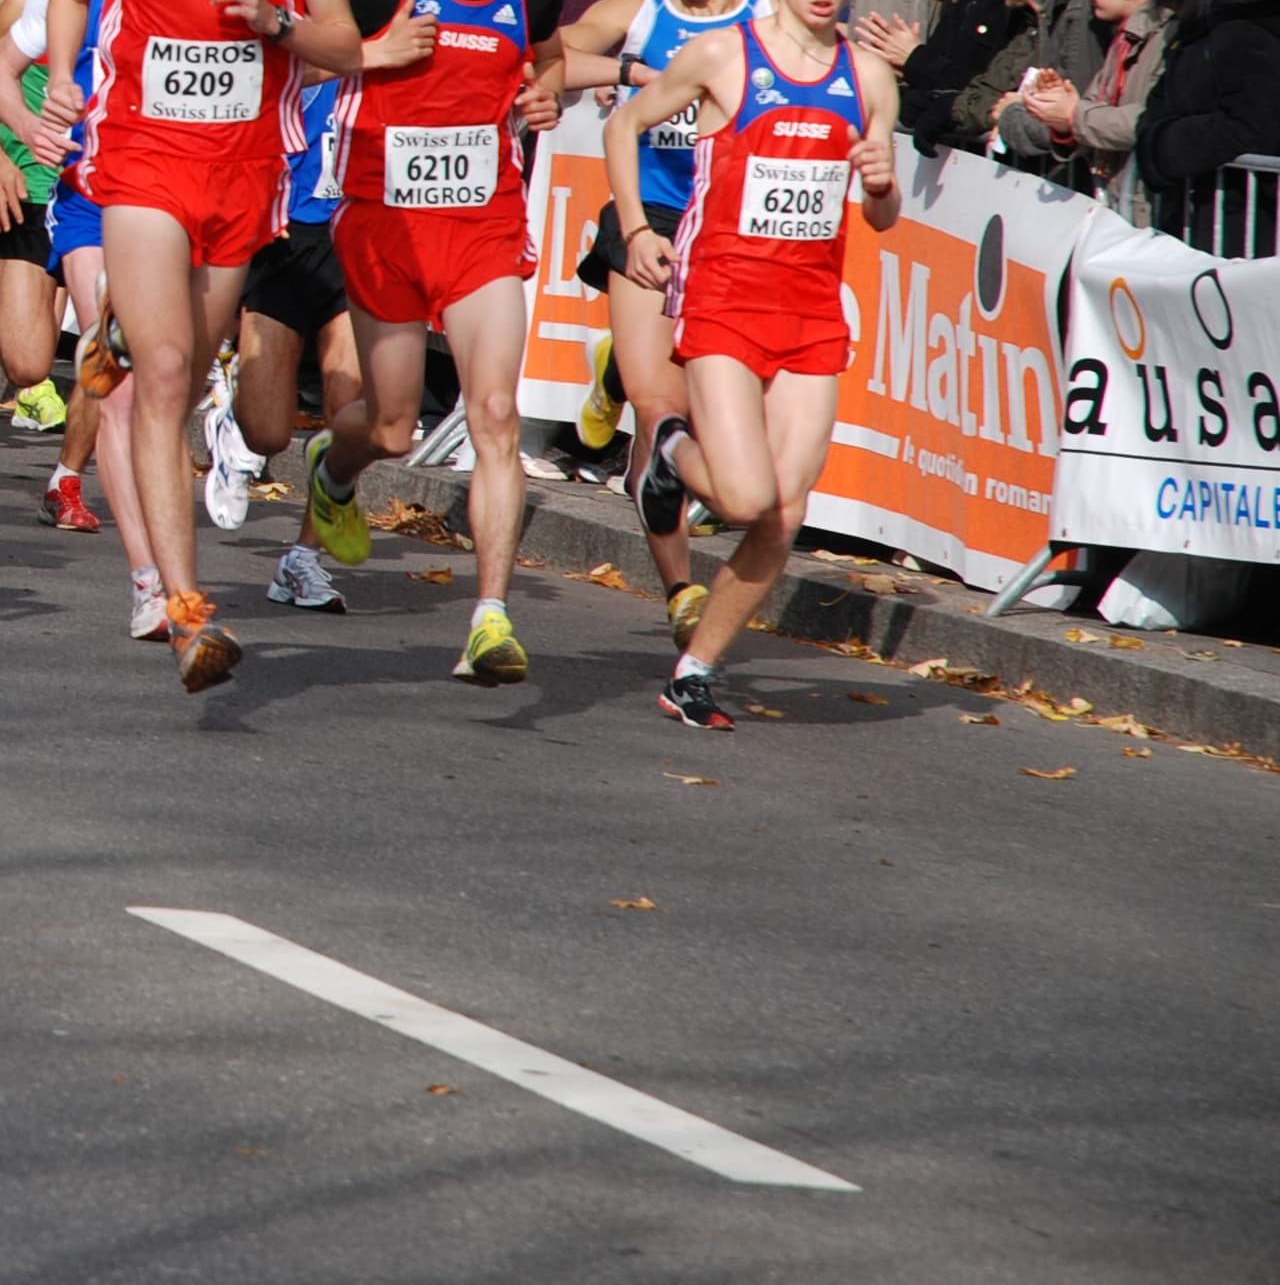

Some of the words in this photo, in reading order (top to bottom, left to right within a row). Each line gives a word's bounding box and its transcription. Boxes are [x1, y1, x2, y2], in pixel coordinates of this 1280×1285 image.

[439, 30, 500, 53] SUISSE
[151, 42, 257, 64] MIGROS
[164, 70, 235, 96] 6209
[152, 101, 207, 119] Swiss
[212, 103, 250, 119] Life
[392, 131, 449, 148] Swiss
[454, 130, 492, 147] Life
[658, 131, 699, 147] MIG
[407, 154, 469, 181] 6210
[752, 163, 805, 182] Swiss
[811, 162, 844, 182] Life
[394, 186, 486, 204] MIGROS
[764, 188, 824, 215] 6208
[750, 217, 832, 238] MIGROS
[867, 249, 1062, 459] Matin
[985, 477, 1053, 516] roman
